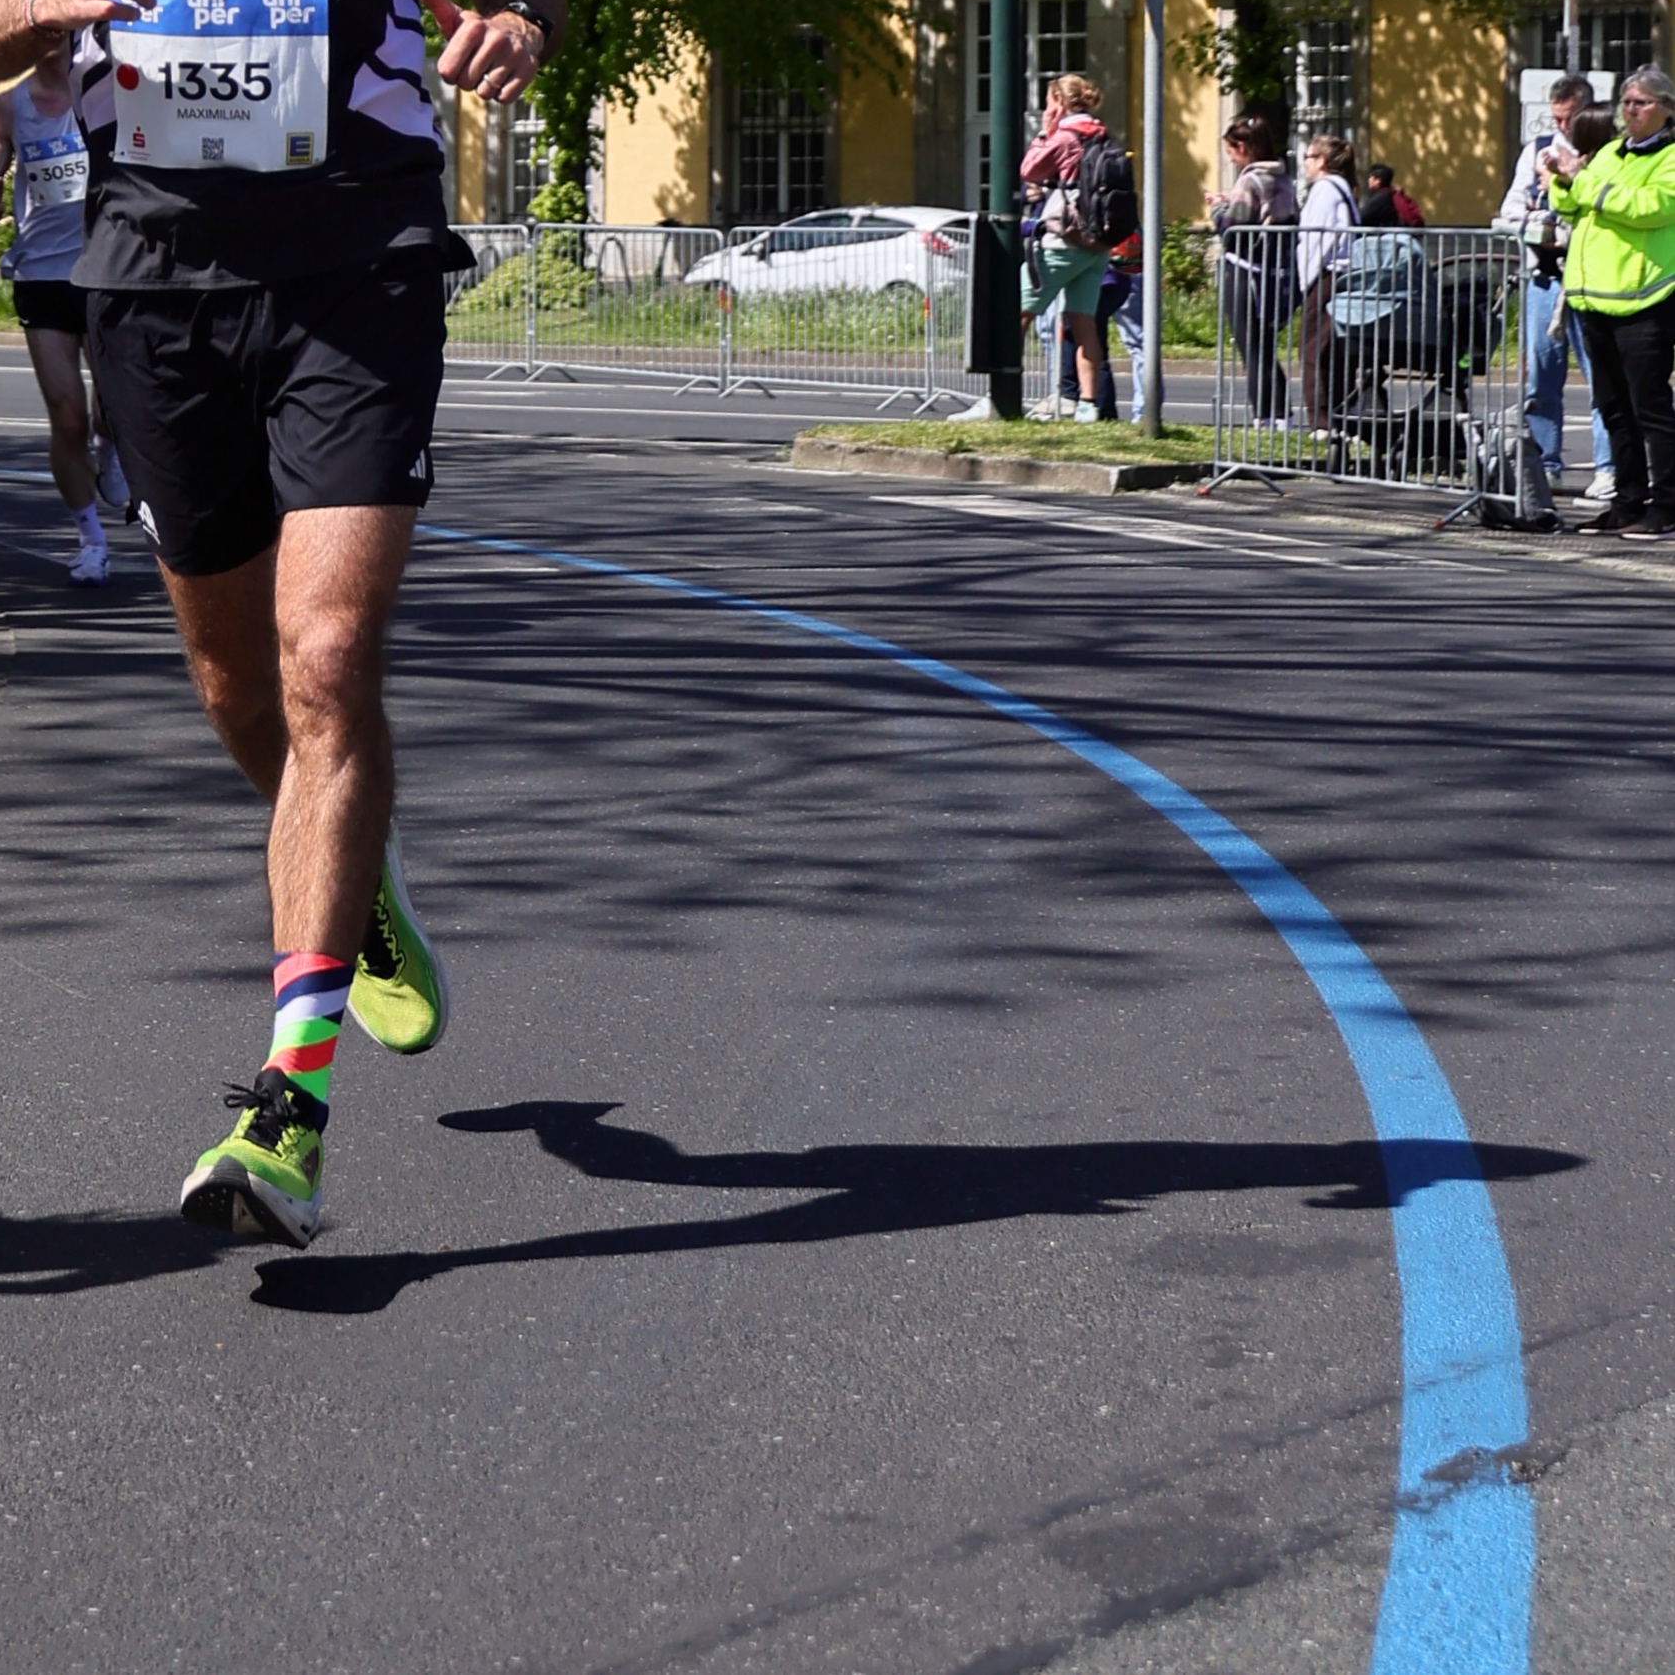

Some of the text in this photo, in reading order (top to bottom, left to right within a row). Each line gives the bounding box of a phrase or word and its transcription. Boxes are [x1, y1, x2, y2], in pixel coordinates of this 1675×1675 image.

[194, 7, 240, 30] per
[270, 5, 316, 30] per
[158, 61, 272, 101] 1335
[177, 107, 251, 122] MAXIMILIAN
[41, 161, 87, 182] 3055
